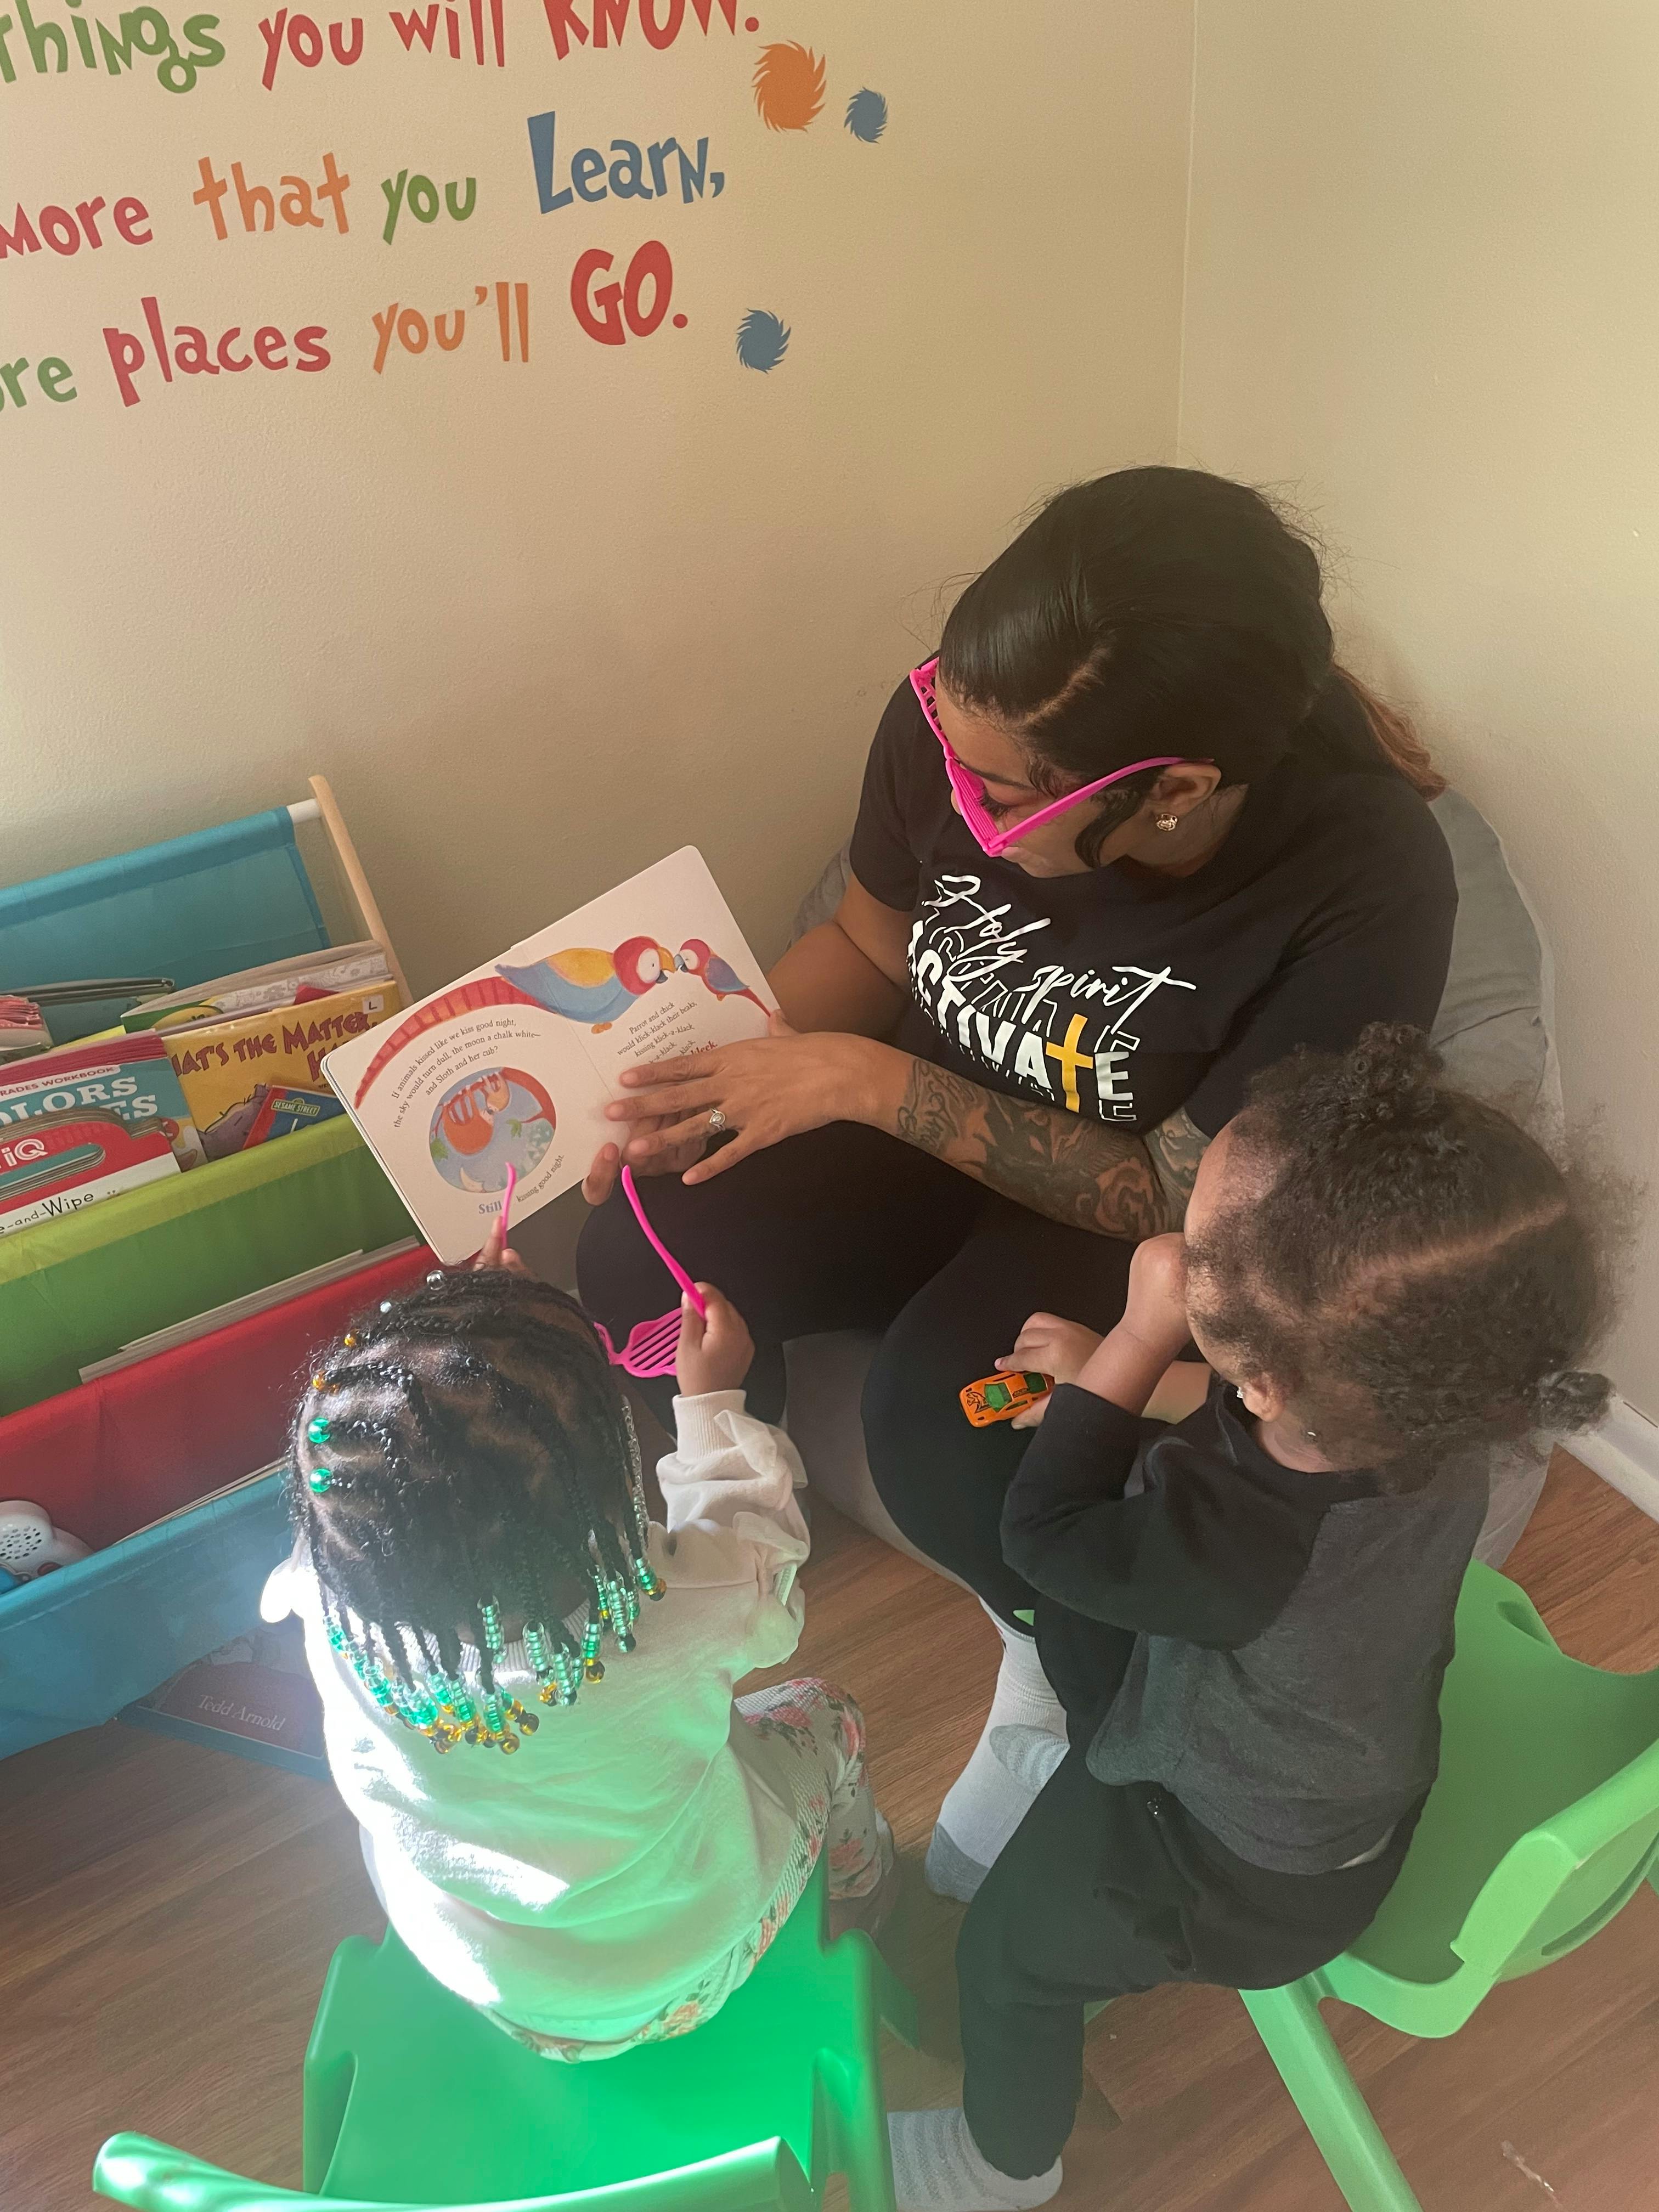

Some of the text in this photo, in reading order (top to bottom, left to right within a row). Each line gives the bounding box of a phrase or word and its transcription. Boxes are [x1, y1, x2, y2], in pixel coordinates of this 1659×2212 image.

[258, 8, 363, 91] you
[389, 0, 504, 67] will
[193, 153, 349, 240] that
[381, 169, 476, 245] you
[527, 111, 724, 214] Learn,
[0, 240, 687, 411] re places you'll GO.
[369, 1001, 377, 1010] L
[629, 1001, 675, 1035] Parrot and chick
[233, 1033, 278, 1063] THE
[617, 1039, 636, 1056] would
[636, 1020, 667, 1044] klick-klack
[667, 1012, 680, 1024] their
[634, 1042, 656, 1057] kissing
[42, 1067, 115, 1086] WORKBOOK
[391, 1018, 517, 1099] If animals kissed like we kiss good night,
[394, 1115, 403, 1128] the
[399, 1101, 411, 1114] sky
[407, 1077, 424, 1099] would
[422, 1064, 437, 1079] turn
[437, 1051, 452, 1066] dull,
[452, 1045, 464, 1056] the
[465, 1036, 485, 1049] moon
[494, 1030, 513, 1040] chalk
[425, 1046, 499, 1096] and Sloth and her cub?
[274, 1101, 318, 1114] SESAME STREET
[478, 1200, 503, 1214] Still
[516, 1186, 539, 1203] kissing
[538, 1171, 552, 1189] good
[198, 1695, 286, 1731] Tedd Arnold
